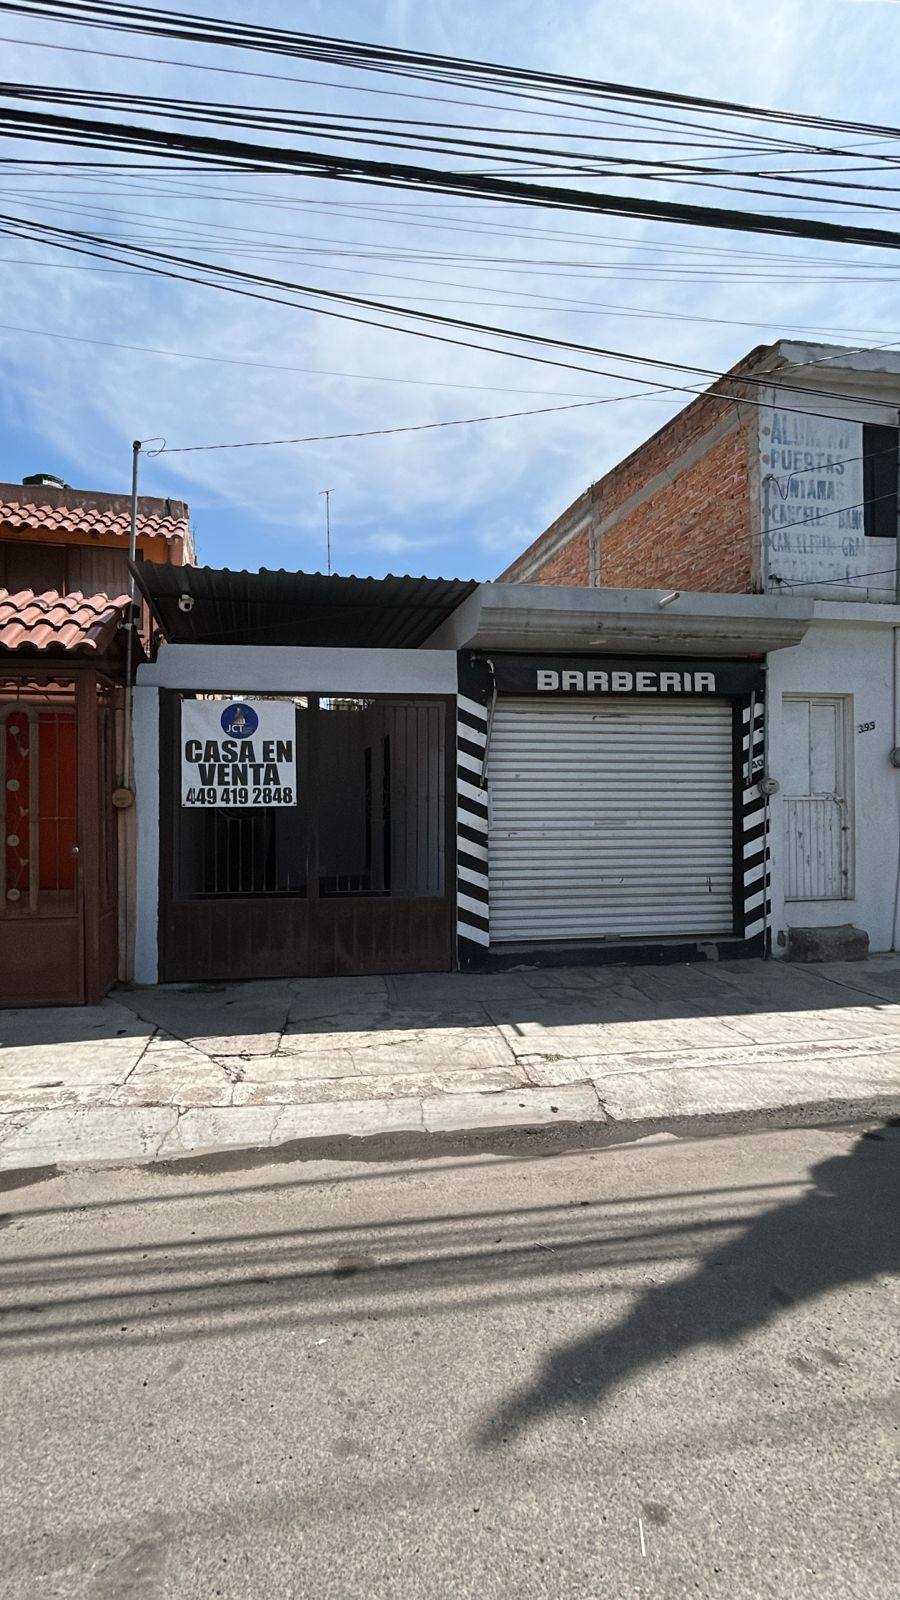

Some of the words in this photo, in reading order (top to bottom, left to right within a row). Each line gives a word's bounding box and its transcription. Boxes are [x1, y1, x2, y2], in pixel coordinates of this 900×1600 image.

[537, 670, 716, 692] BARBERIA
[226, 725, 245, 733] JCT
[185, 740, 256, 763] CASA
[262, 740, 293, 763] EN
[198, 764, 281, 786] VENTA
[186, 788, 217, 804] 449
[221, 787, 249, 804] 419
[252, 787, 293, 804] 2848
